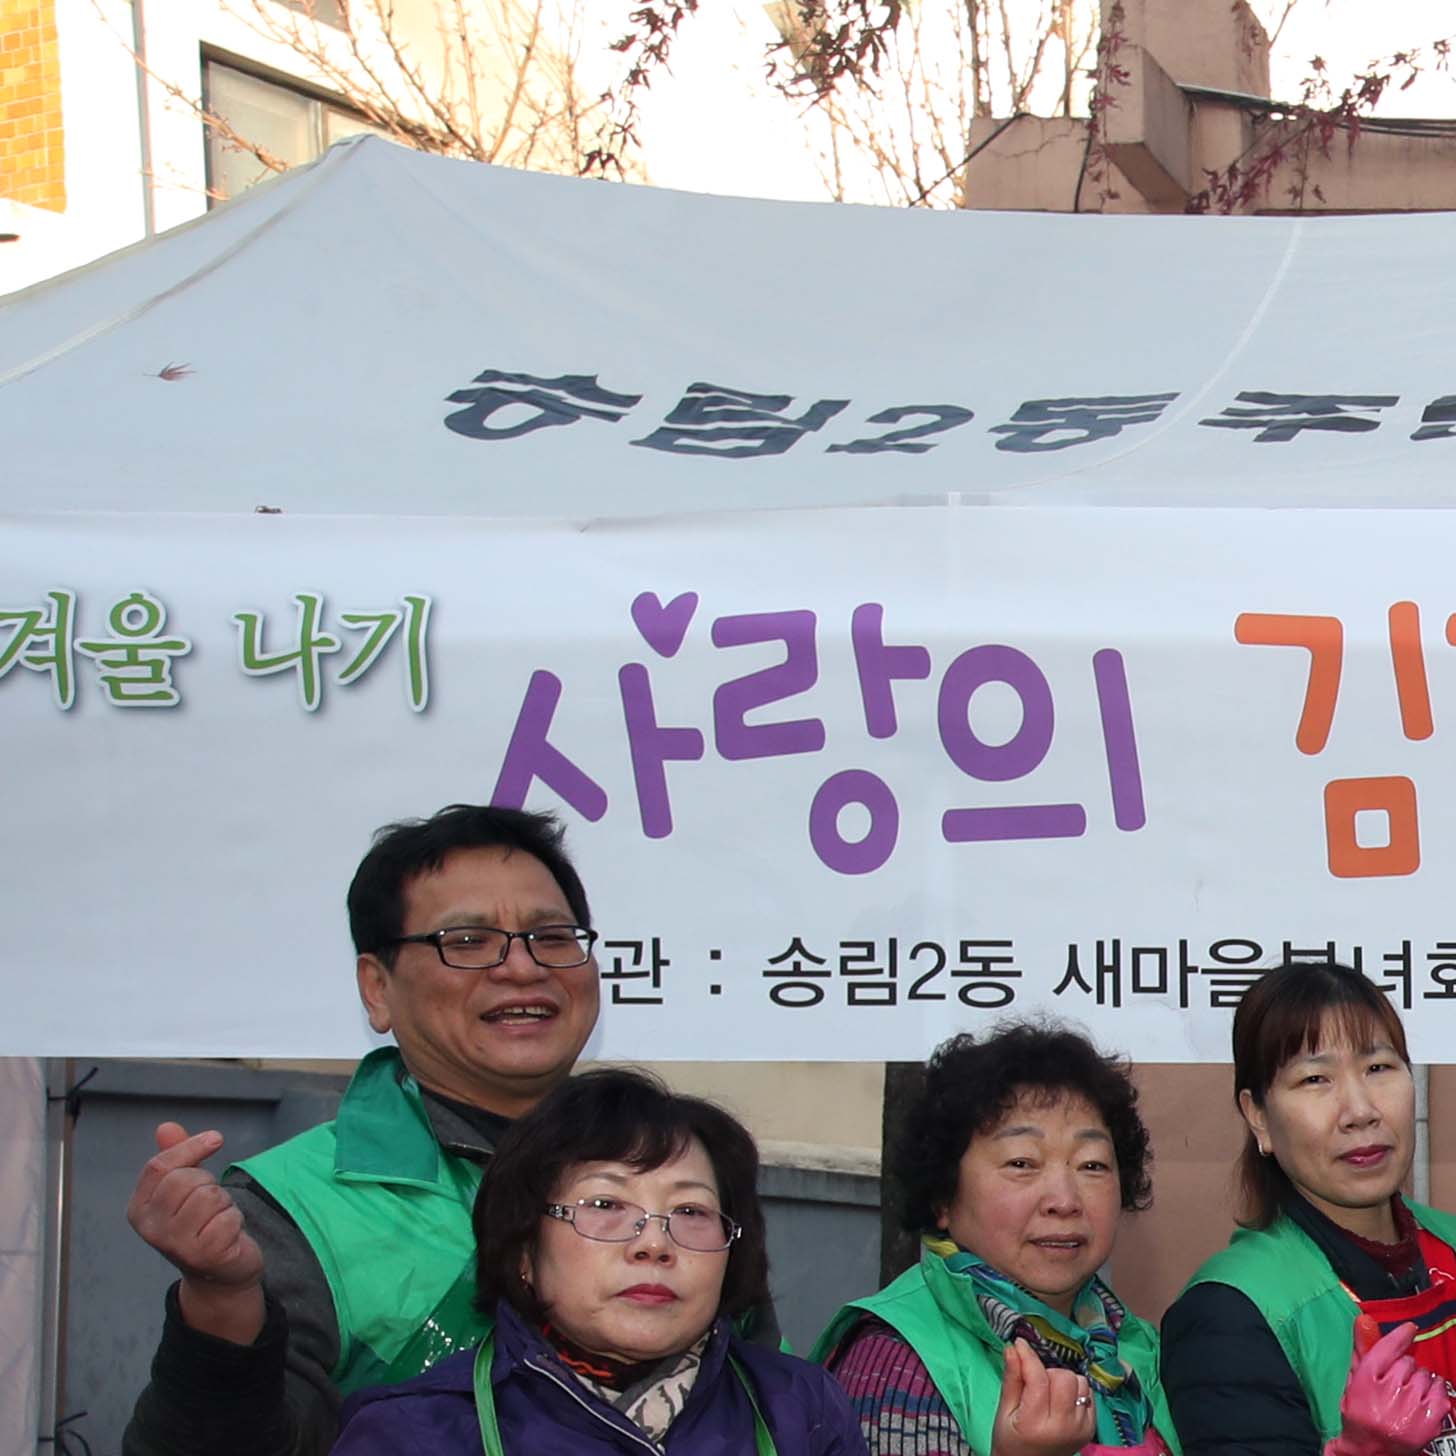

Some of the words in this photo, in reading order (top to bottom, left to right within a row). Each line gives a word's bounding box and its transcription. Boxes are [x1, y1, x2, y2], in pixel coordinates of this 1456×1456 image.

[0, 590, 190, 708] 겨울
[231, 593, 431, 709] 나기
[487, 592, 1147, 875] 사랑의
[762, 936, 1024, 1008] 송림2동
